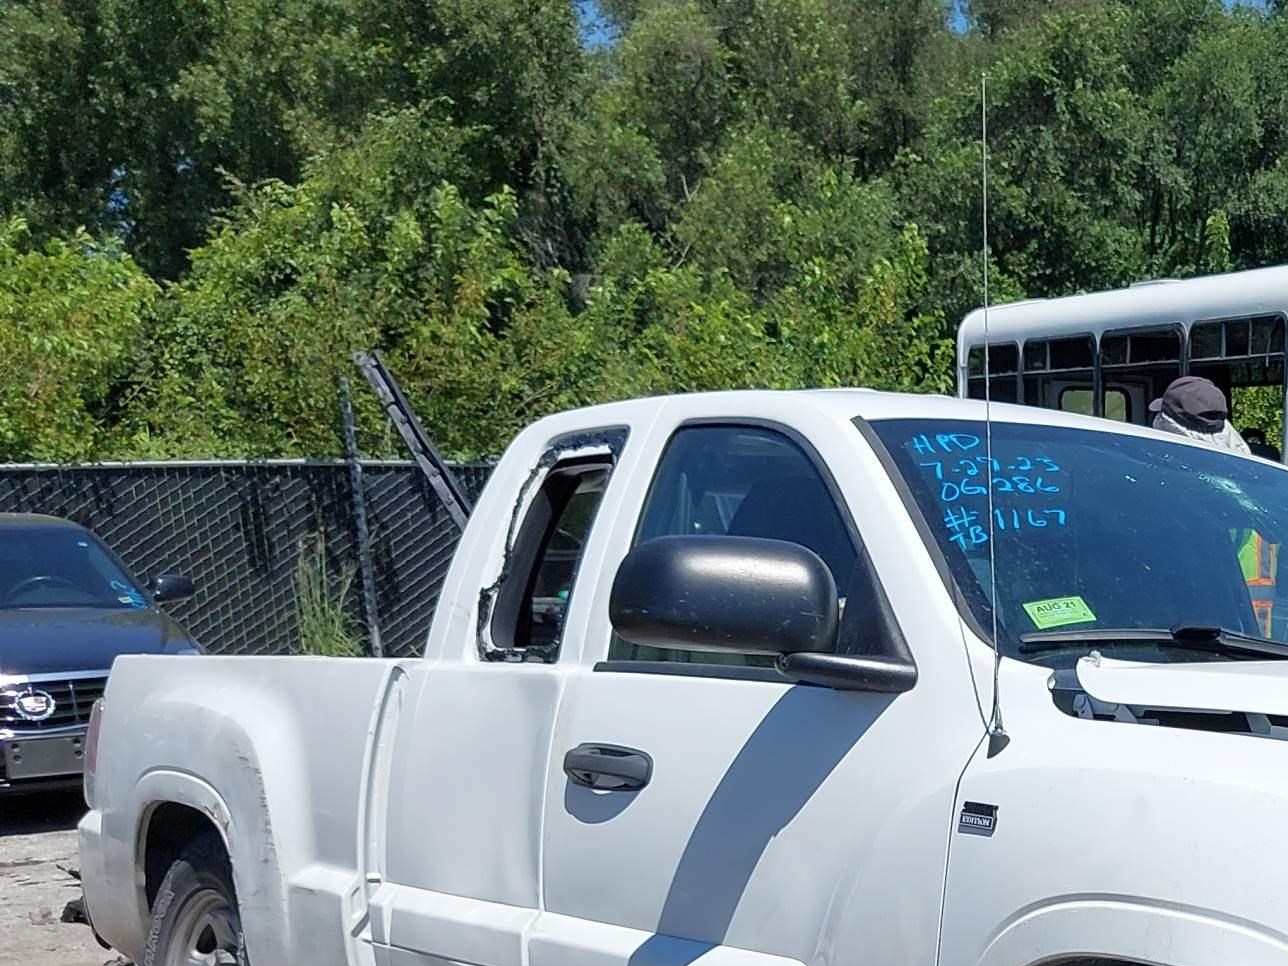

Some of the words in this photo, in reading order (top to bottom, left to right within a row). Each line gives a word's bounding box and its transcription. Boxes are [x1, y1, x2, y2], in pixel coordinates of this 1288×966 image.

[912, 434, 980, 454] HPD
[1036, 602, 1061, 613] AUG
[1063, 601, 1076, 609] 21
